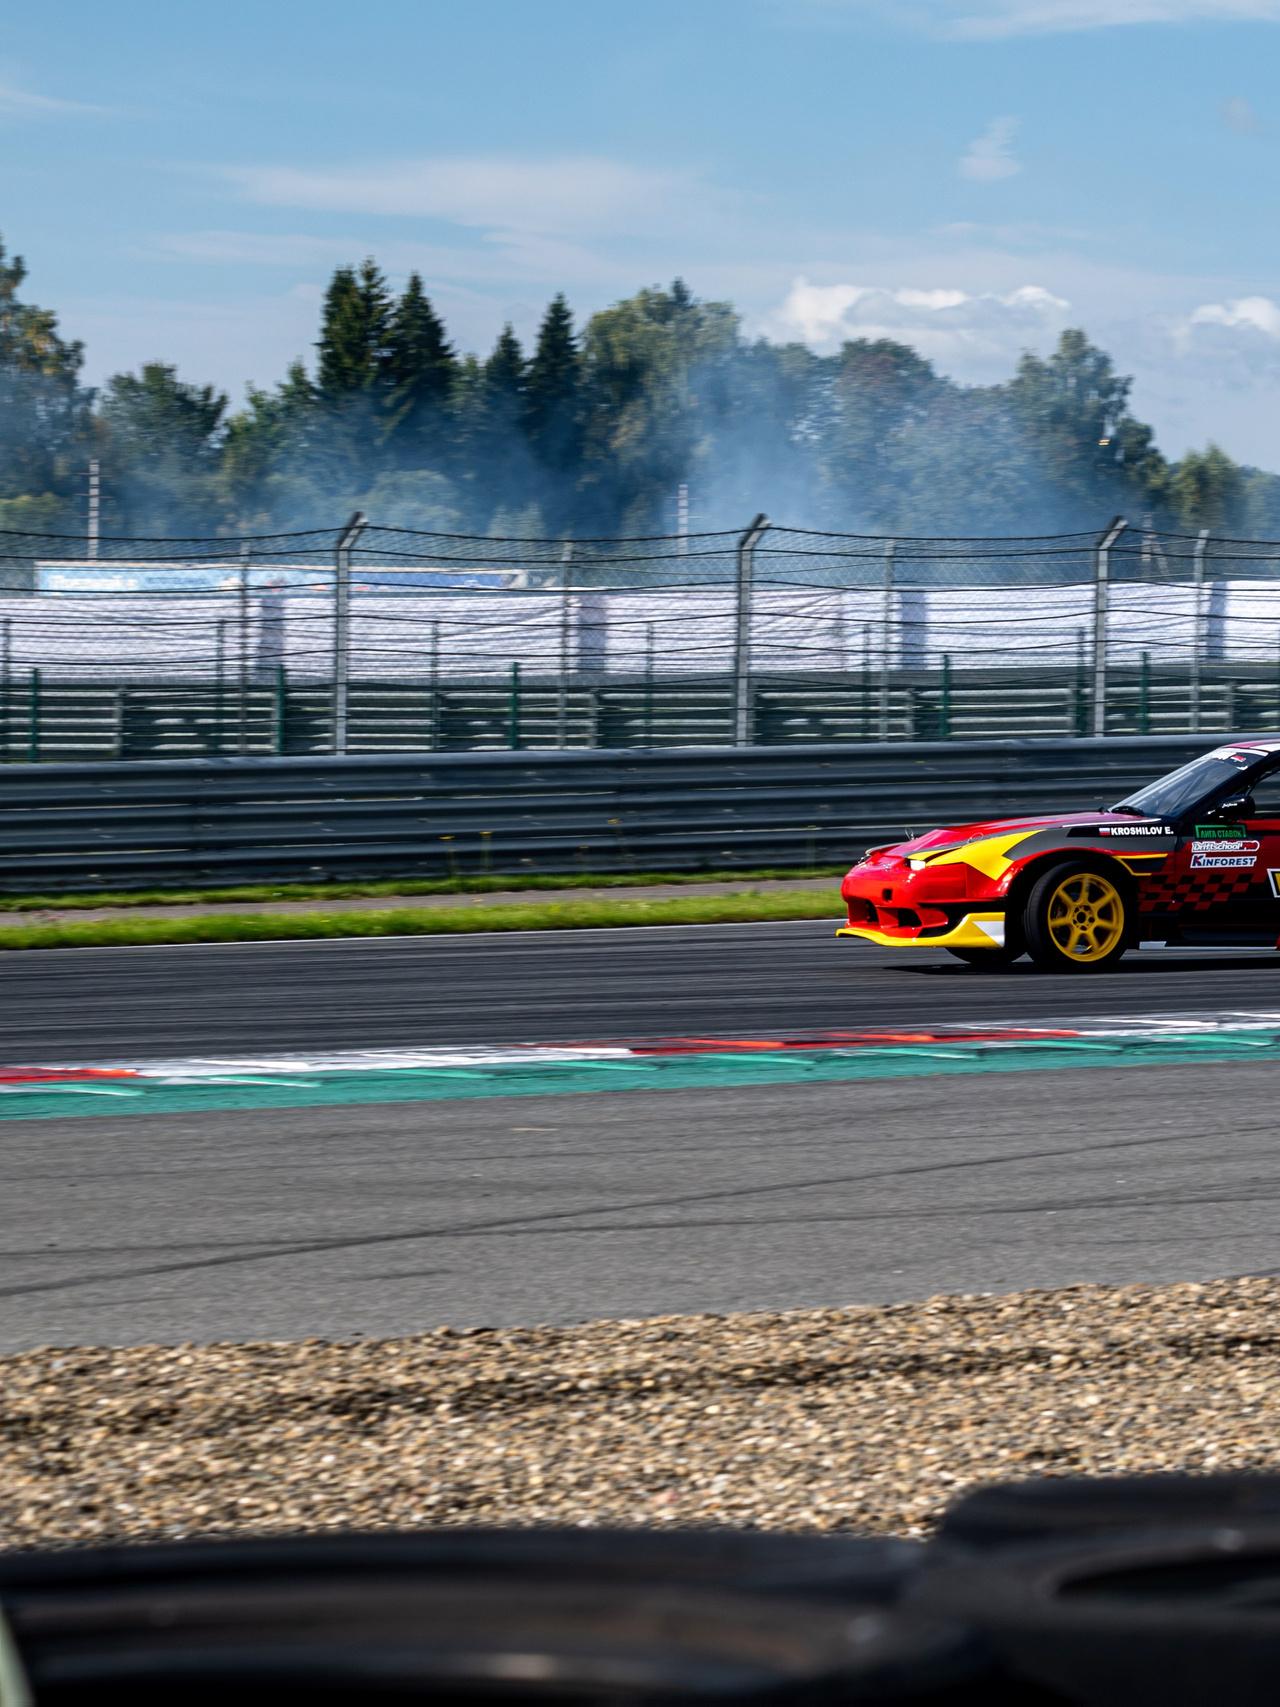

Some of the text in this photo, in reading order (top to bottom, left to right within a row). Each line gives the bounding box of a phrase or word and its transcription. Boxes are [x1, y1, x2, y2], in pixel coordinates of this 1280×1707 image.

[1110, 826, 1174, 836] KROSHILOV E.
[1201, 830, 1242, 838] ЛИГА СТАВОК
[1192, 854, 1255, 867] KINFOREST
